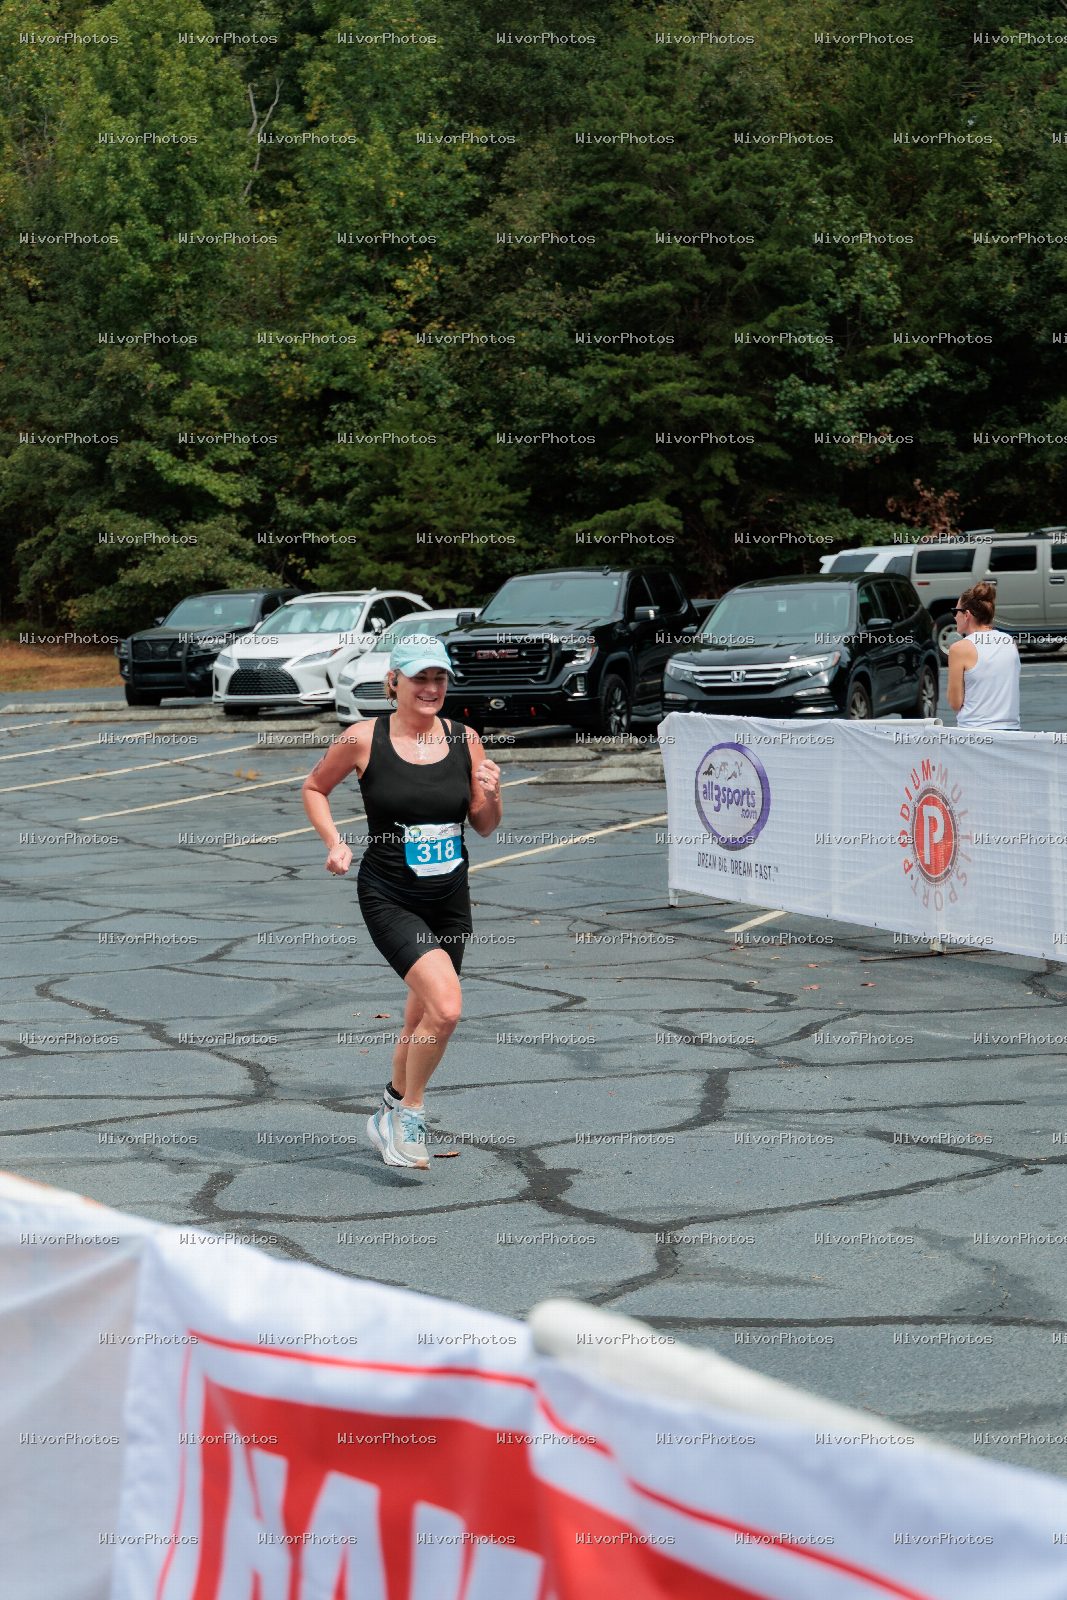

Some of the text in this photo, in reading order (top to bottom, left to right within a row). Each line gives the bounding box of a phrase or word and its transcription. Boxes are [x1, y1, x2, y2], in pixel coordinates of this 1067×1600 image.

[476, 648, 519, 660] GMC
[899, 758, 933, 875] PODIUM
[922, 804, 945, 865] P
[417, 839, 455, 863] 318
[697, 852, 717, 870] DREAM
[730, 859, 753, 878] DREAM
